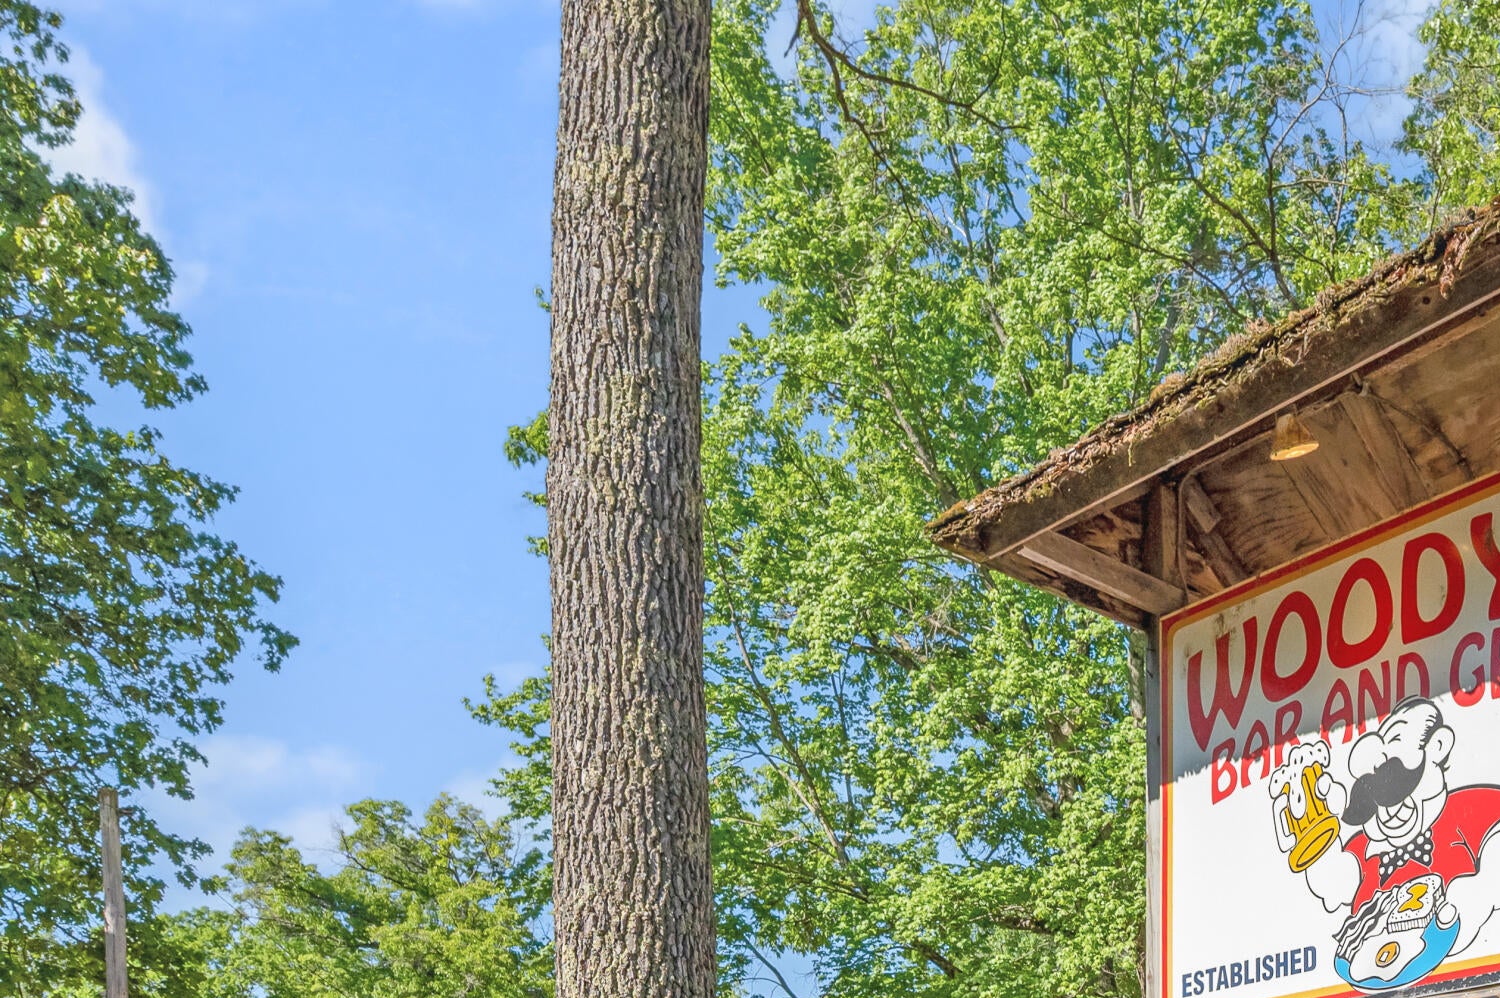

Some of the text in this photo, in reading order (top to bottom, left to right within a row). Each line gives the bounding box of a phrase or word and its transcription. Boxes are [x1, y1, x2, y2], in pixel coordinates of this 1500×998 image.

[1211, 700, 1303, 805] BAR
[1320, 652, 1430, 749] AND
[1181, 945, 1318, 998] ESTABLISHED
